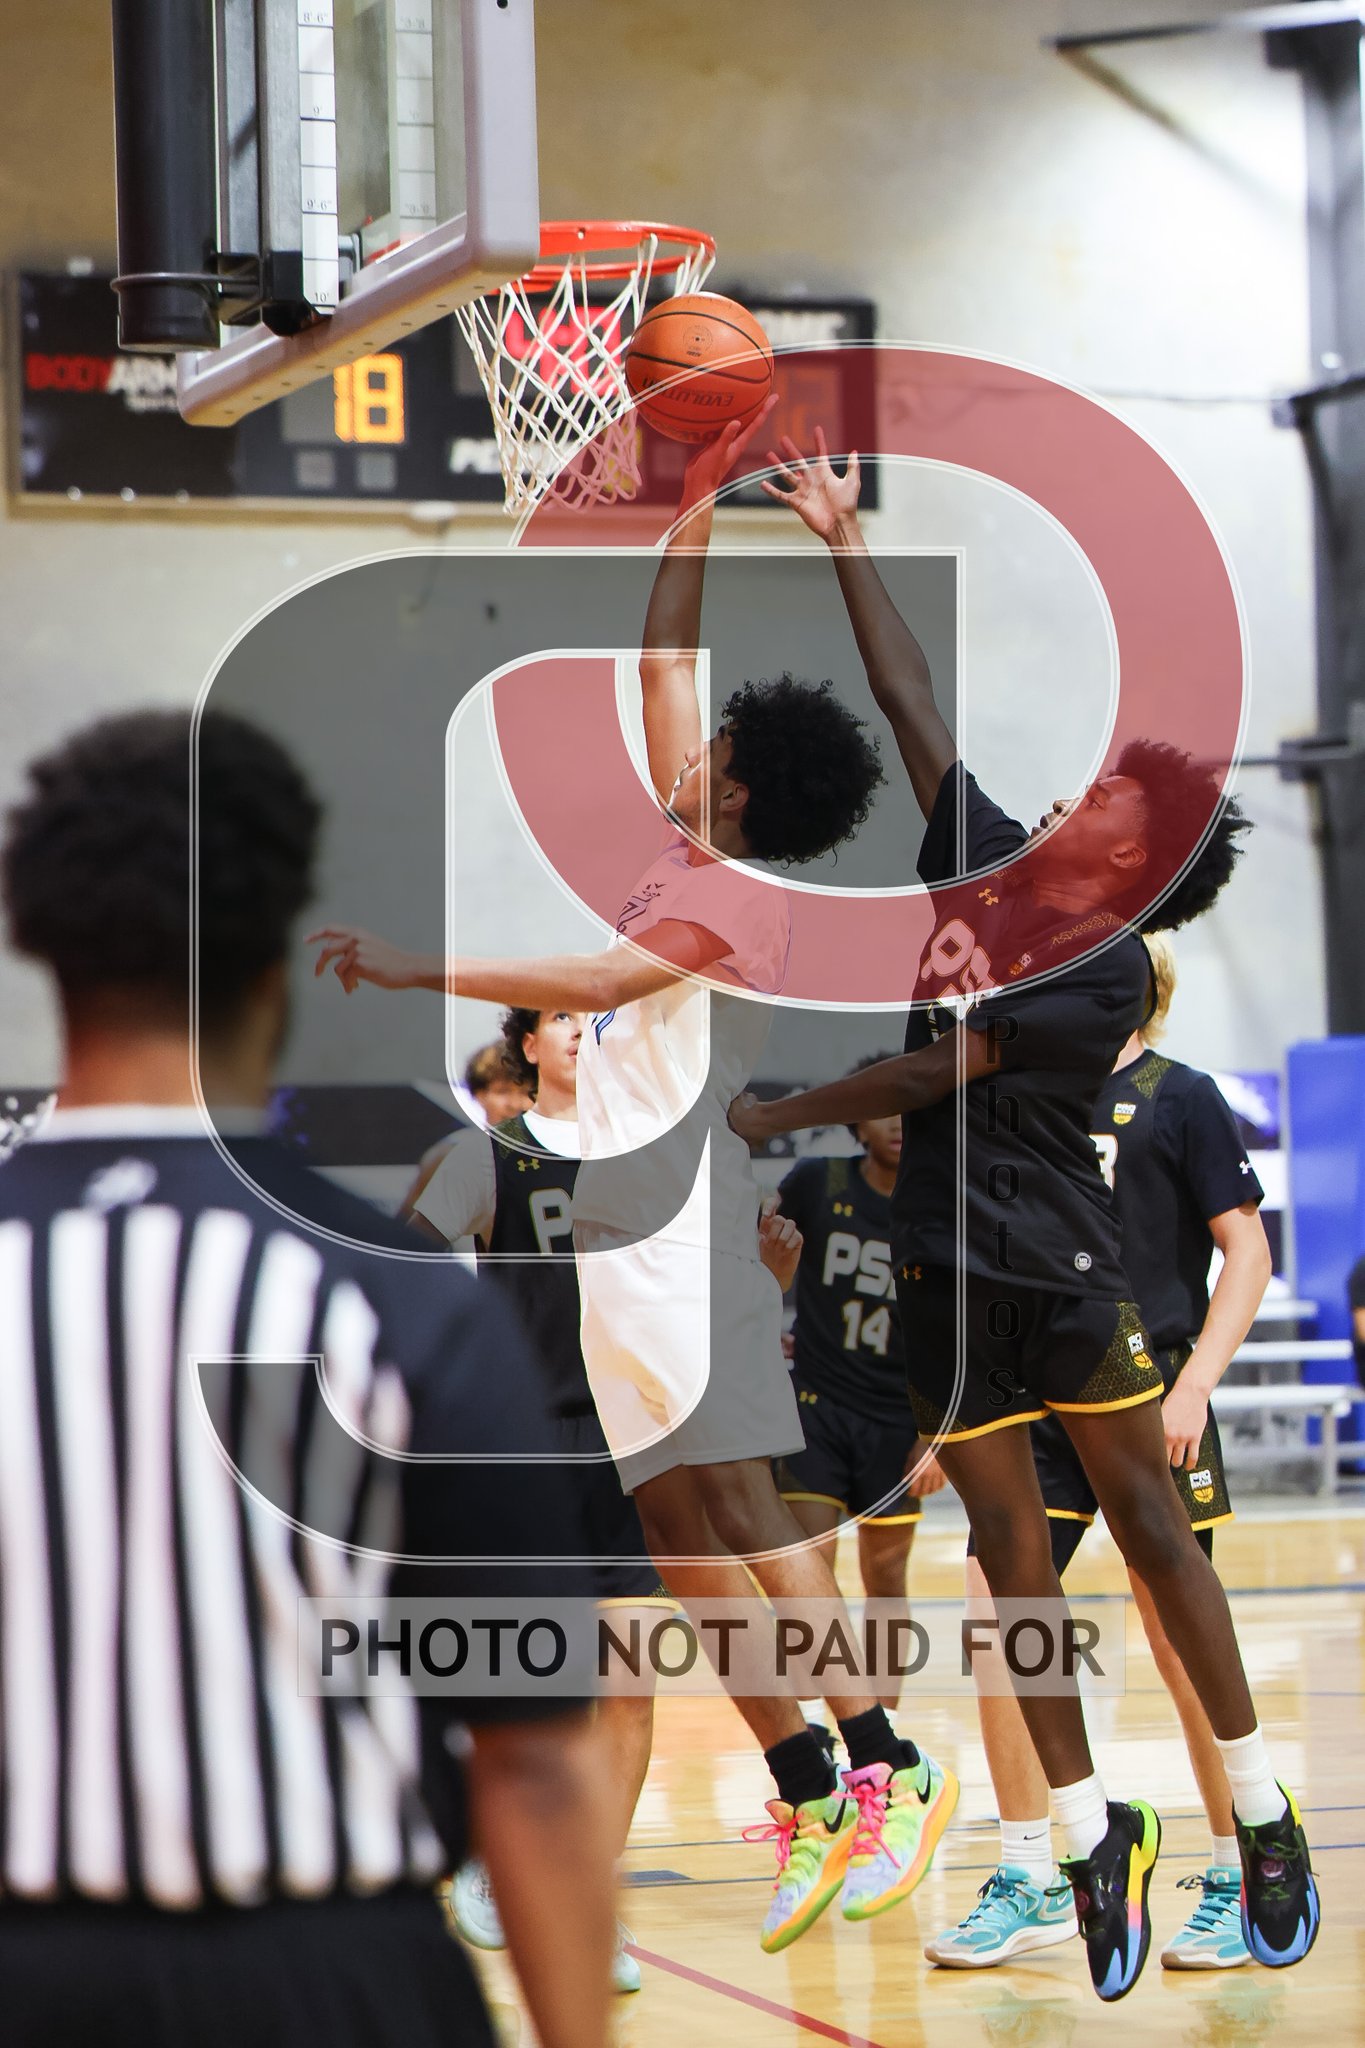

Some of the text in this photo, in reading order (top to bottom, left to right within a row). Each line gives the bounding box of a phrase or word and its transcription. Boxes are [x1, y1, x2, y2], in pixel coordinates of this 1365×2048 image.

[334, 353, 405, 443] 18
[822, 1232, 897, 1300] PS
[842, 1299, 891, 1355] 14
